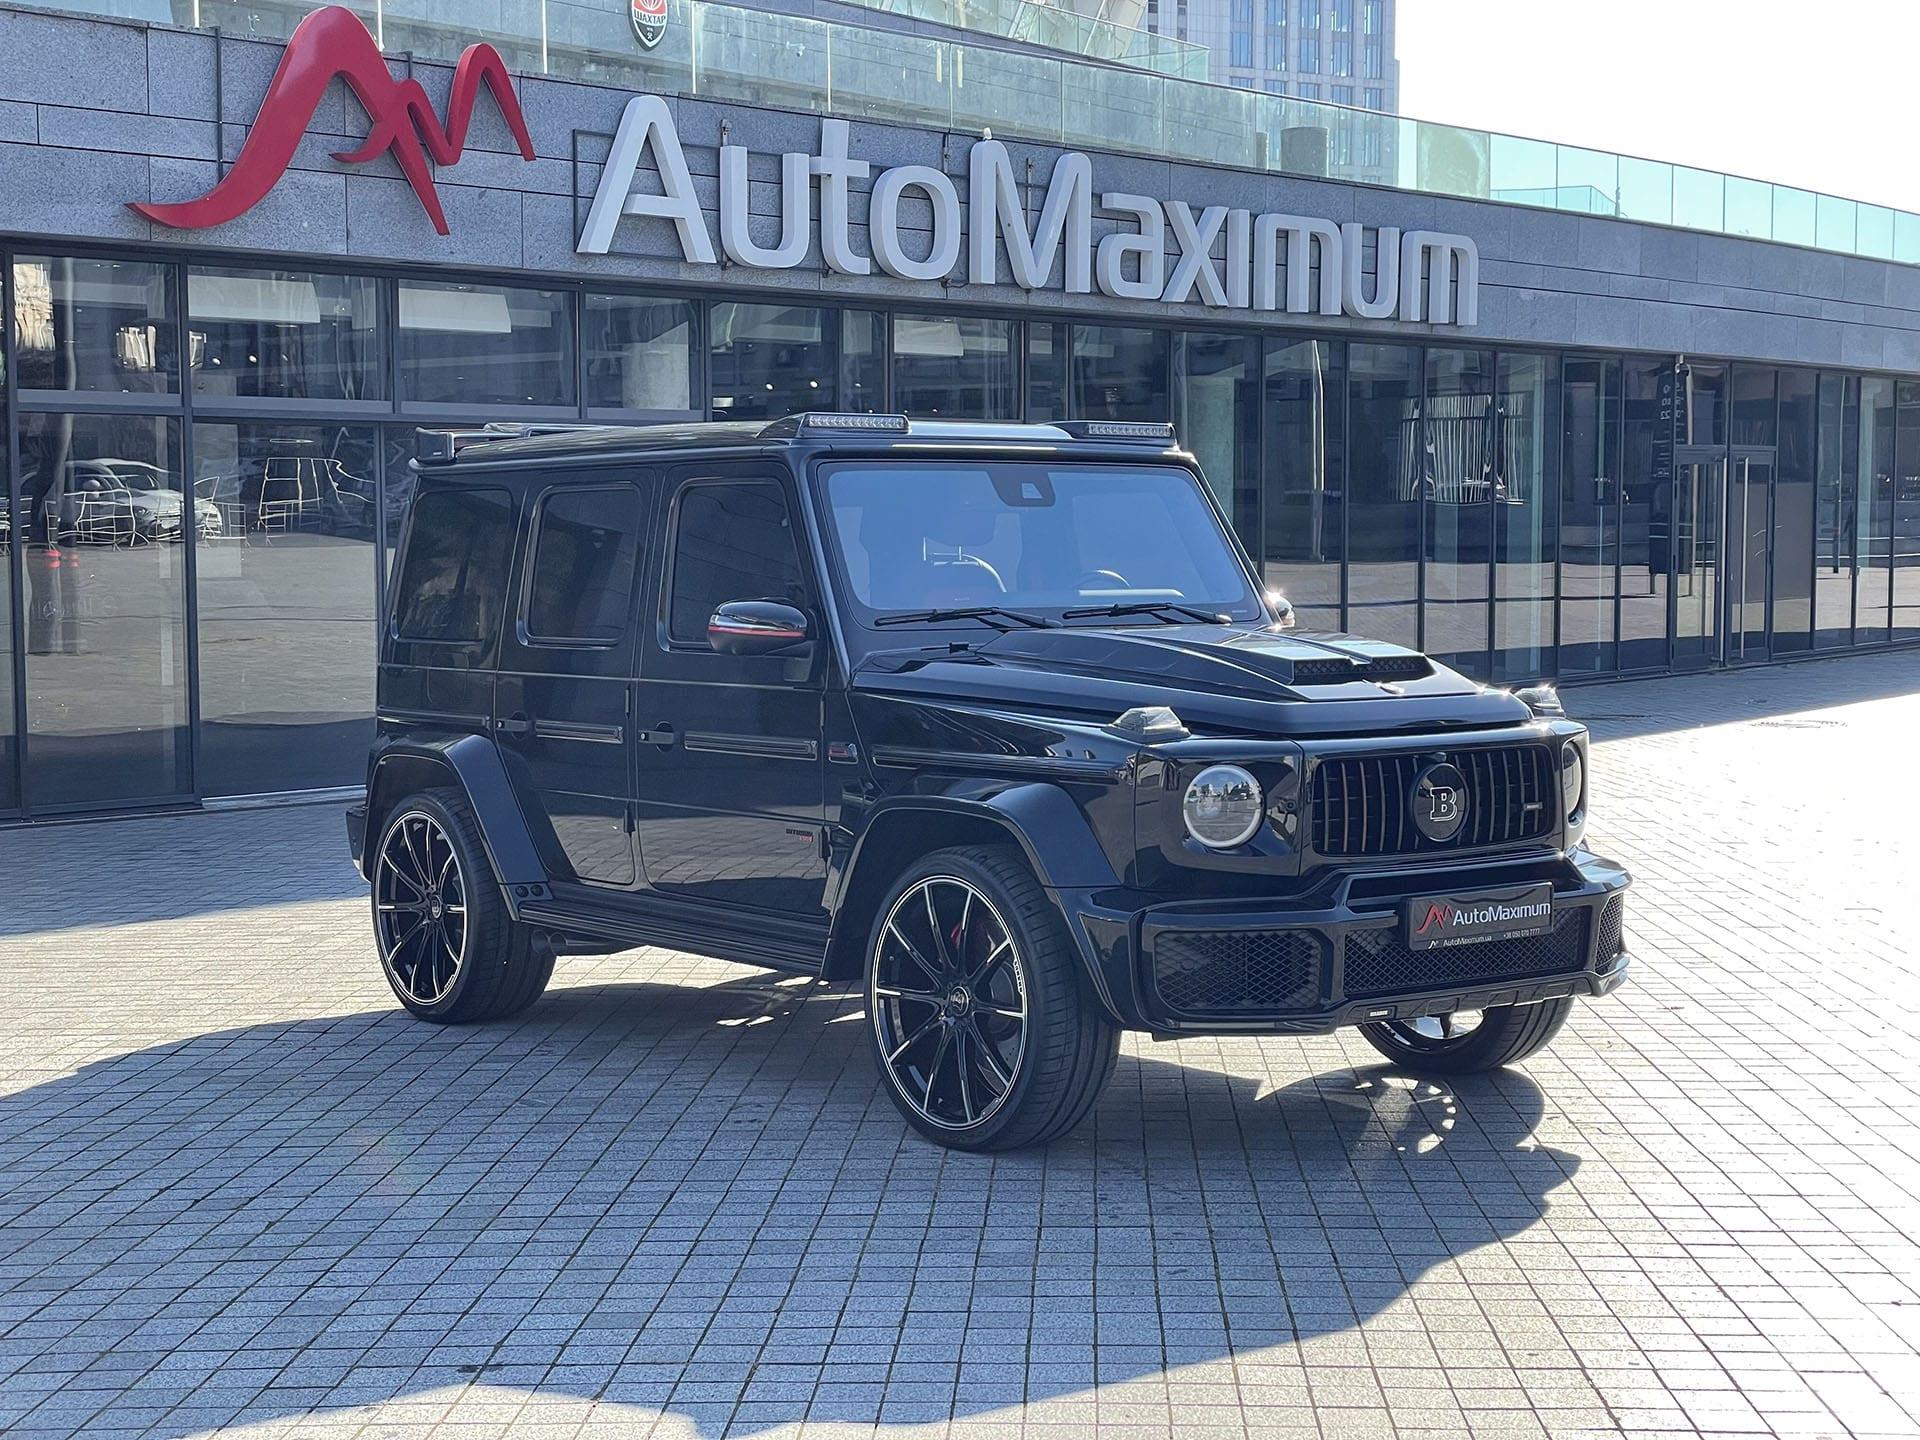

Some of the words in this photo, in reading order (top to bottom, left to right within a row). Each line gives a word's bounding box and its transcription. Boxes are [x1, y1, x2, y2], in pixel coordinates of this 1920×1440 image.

[634, 9, 666, 24] ШАХТАР
[576, 95, 1480, 326] AutoMaximum
[1430, 786, 1458, 822] B
[1452, 903, 1551, 927] AutoMaximum
